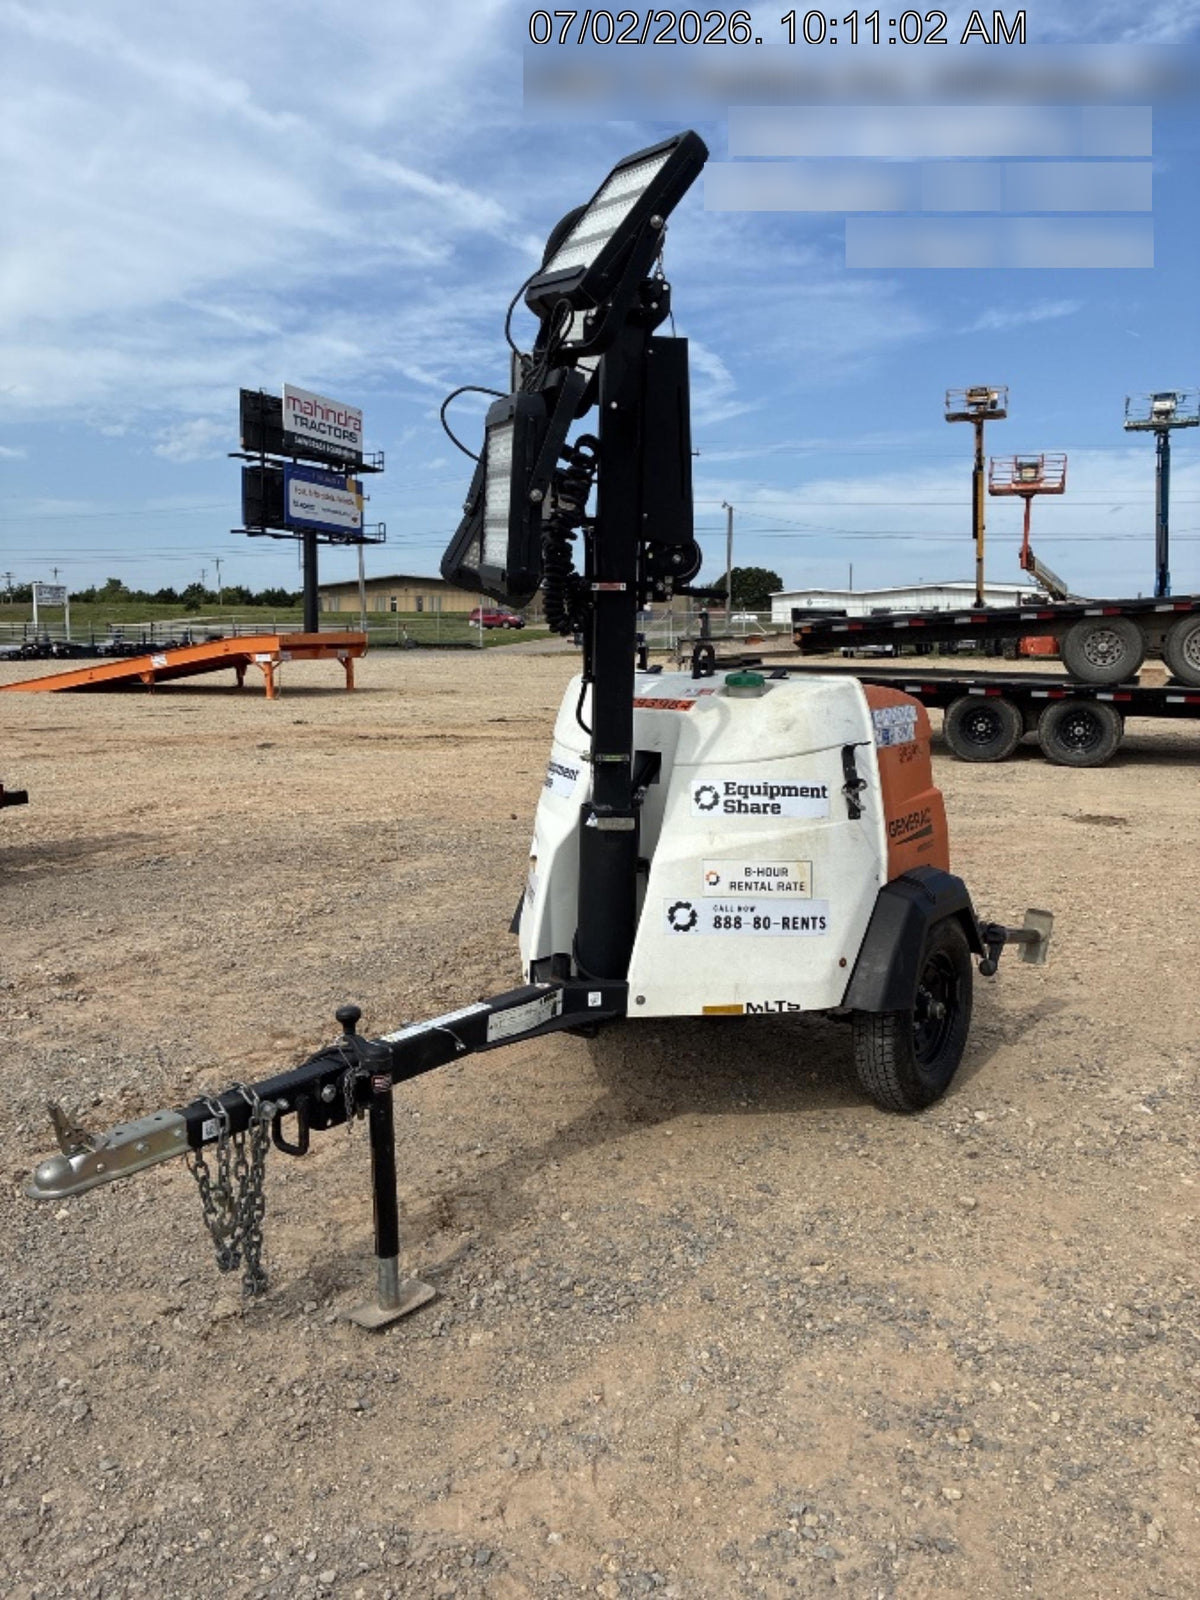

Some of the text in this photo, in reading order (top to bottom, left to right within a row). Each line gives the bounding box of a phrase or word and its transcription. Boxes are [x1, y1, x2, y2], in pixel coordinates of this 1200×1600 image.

[286, 395, 361, 432] mahindra
[293, 414, 358, 443] TRACTORS
[723, 781, 828, 800] Equipment
[723, 799, 782, 815] Share
[729, 881, 806, 892] RENTAL RATE
[713, 904, 756, 913] CALL NOW
[712, 915, 827, 931] 888-80-RENTS
